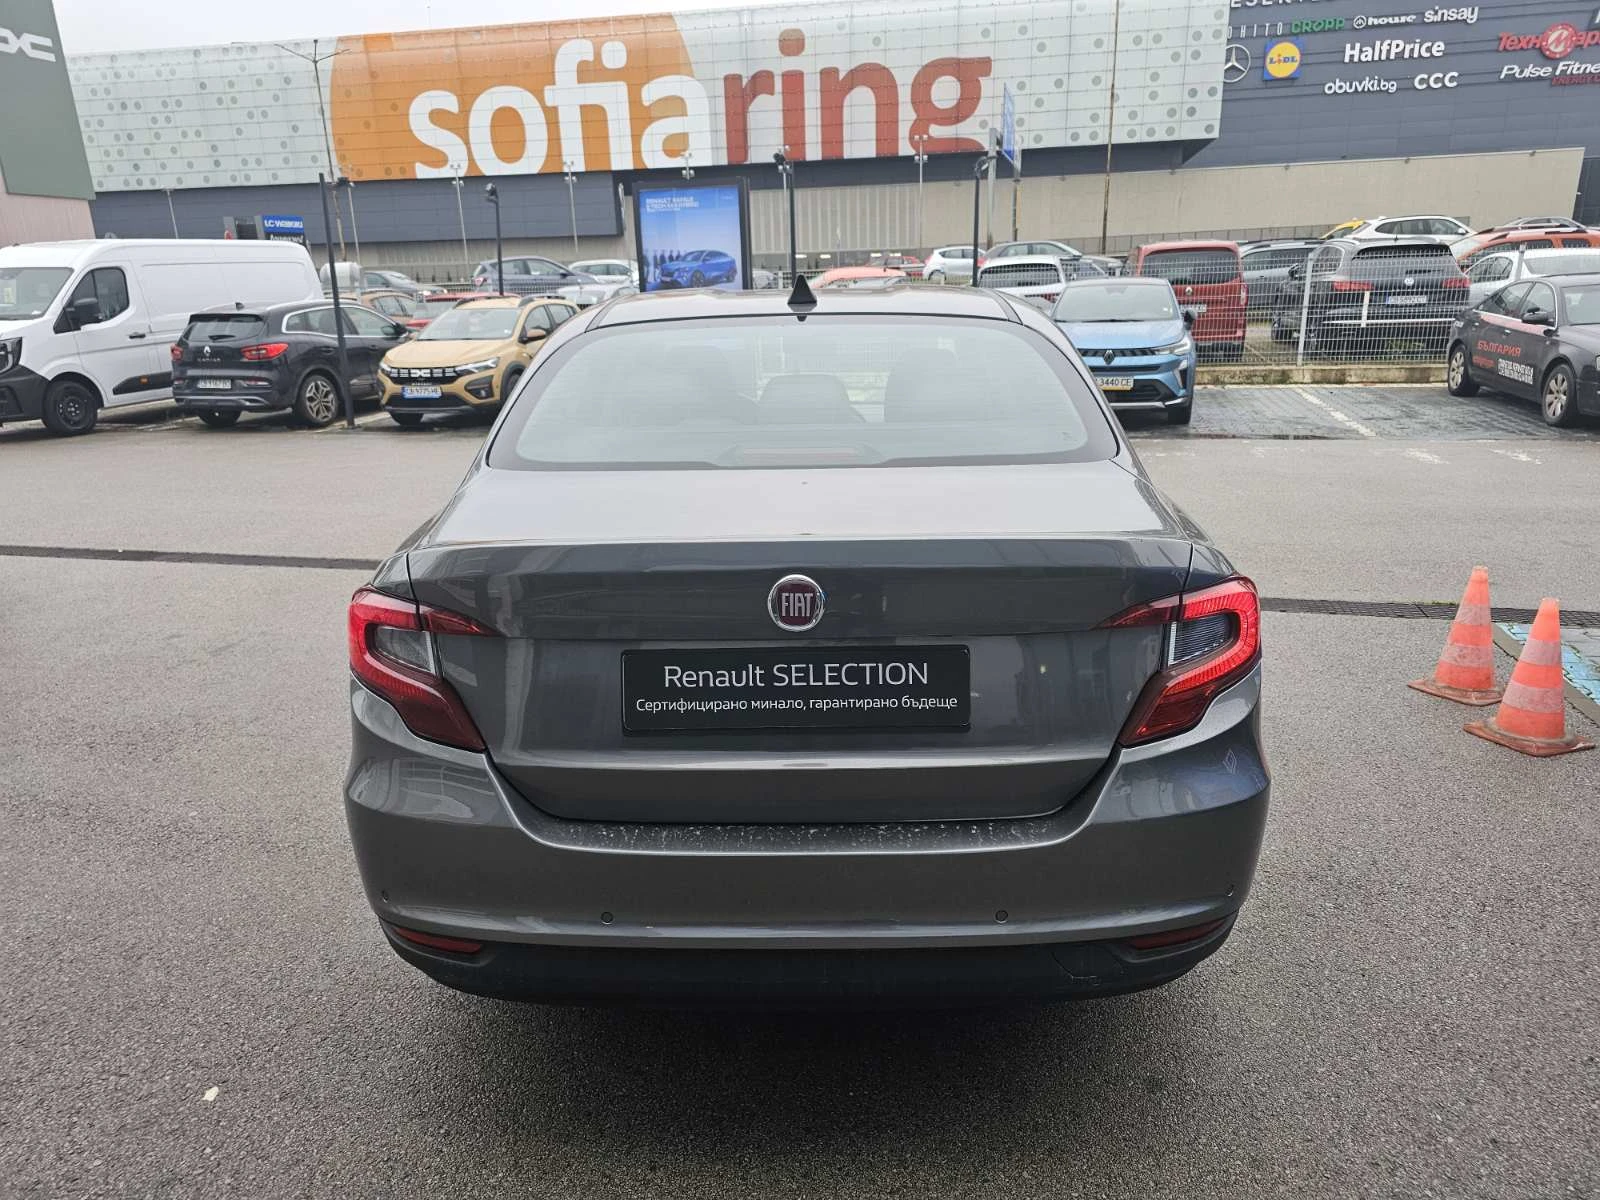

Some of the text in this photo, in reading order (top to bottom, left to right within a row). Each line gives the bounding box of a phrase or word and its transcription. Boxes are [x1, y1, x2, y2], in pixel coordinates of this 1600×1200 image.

[1423, 5, 1479, 24] sinsay
[1291, 17, 1345, 34] CROPP
[1344, 39, 1445, 63] HalfPrice
[1414, 71, 1459, 90] CCC
[1500, 63, 1553, 79] Pulse
[1324, 76, 1397, 95] obuvki.bg
[1477, 340, 1521, 357] БЪЛГАРИЯ
[781, 592, 814, 617] FIAT
[664, 662, 928, 688] Renault SELECTION
[636, 695, 958, 714] Сертифицирано минало, гарантирано бъдеще
